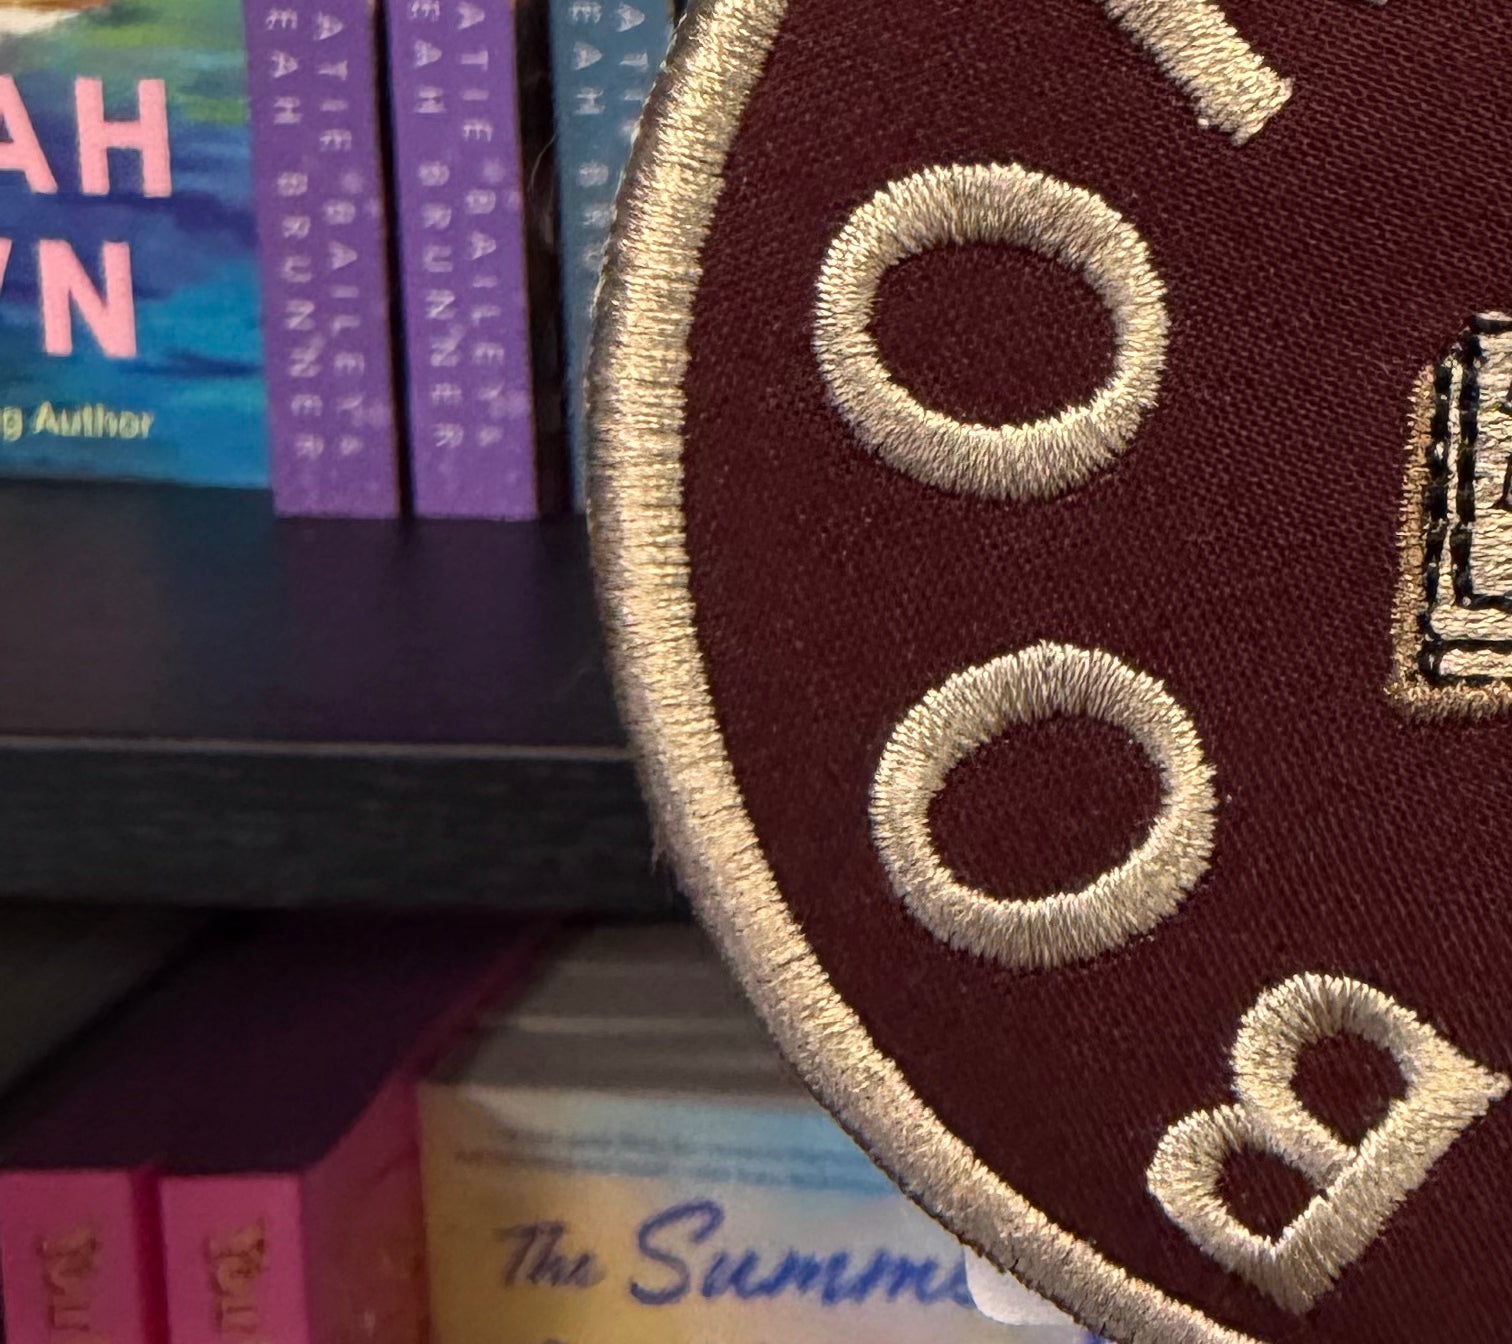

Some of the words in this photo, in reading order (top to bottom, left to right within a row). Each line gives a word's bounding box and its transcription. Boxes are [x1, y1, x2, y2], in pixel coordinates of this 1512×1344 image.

[276, 172, 325, 459] BRUNNER
[323, 198, 366, 416] BAILEY
[417, 161, 464, 449] BRUNNER
[465, 189, 505, 404] BAILEY
[33, 400, 154, 440] Author
[497, 1221, 605, 1288] The
[630, 1200, 977, 1308] Summe
